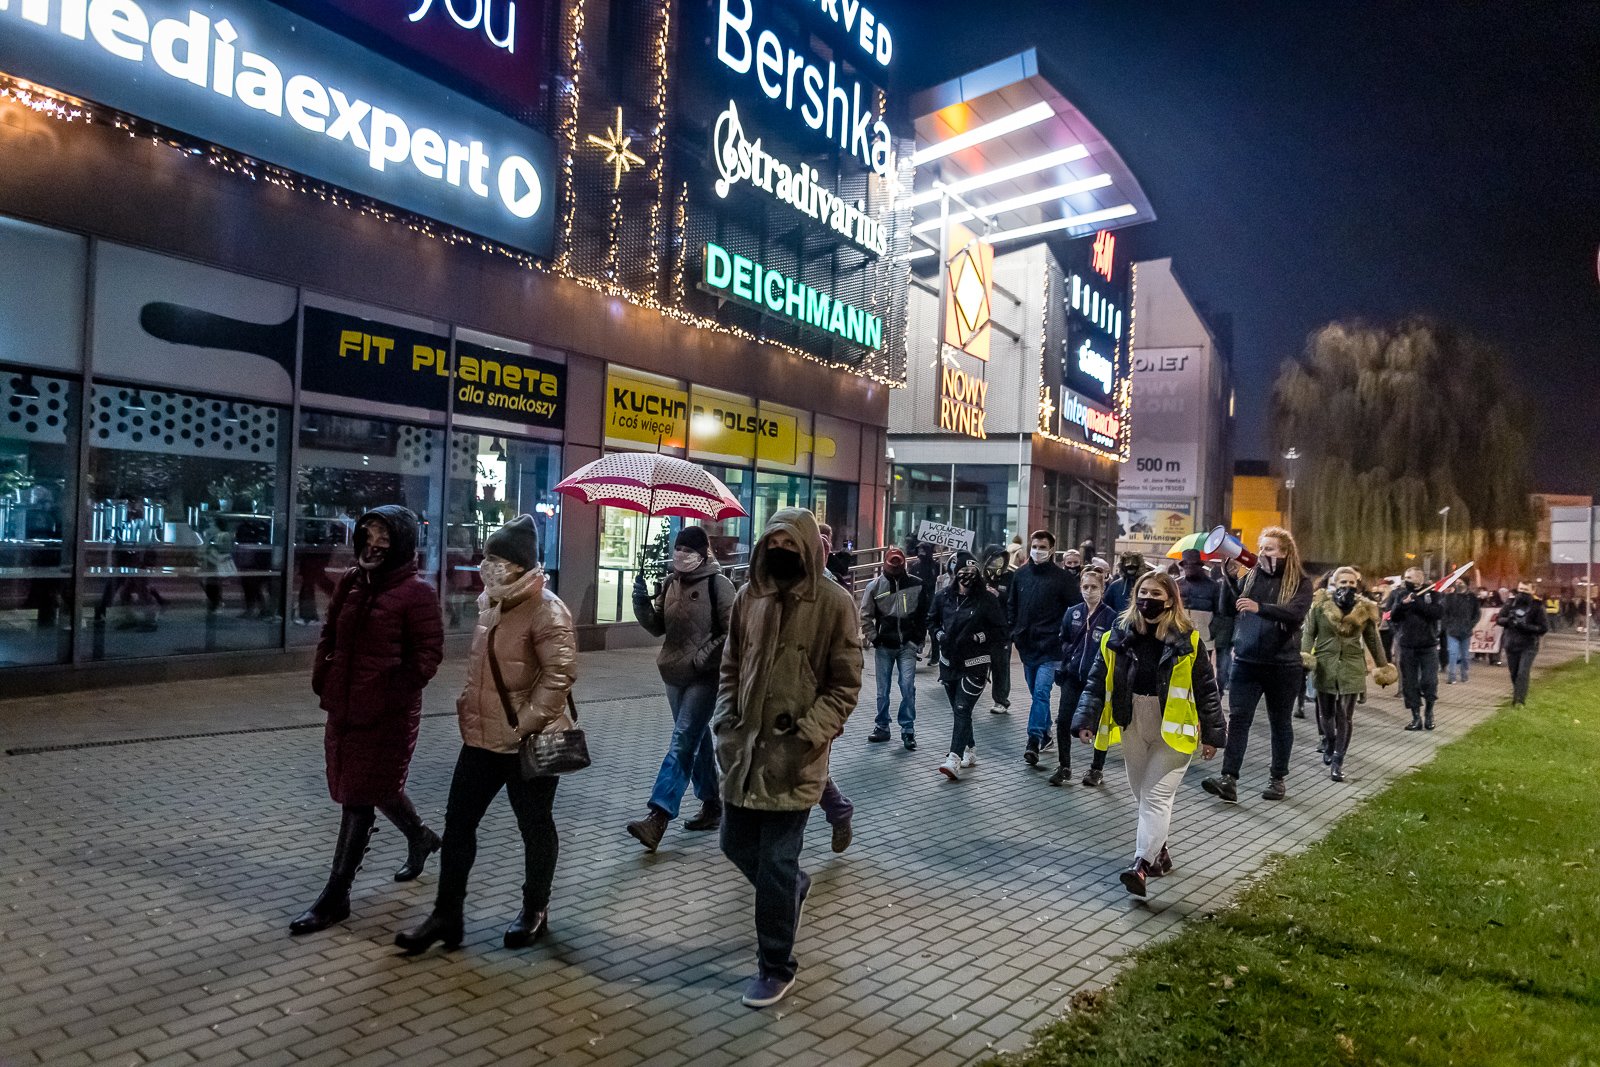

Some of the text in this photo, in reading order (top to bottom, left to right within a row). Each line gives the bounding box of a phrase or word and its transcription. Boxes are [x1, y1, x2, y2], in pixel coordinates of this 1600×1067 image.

[718, 0, 893, 178] Bershka
[706, 243, 882, 350] DEICHMANN
[339, 329, 394, 365] FIT
[458, 384, 557, 418] dla smakoszy
[942, 365, 989, 410] NOWY
[618, 415, 638, 430] coś
[641, 419, 675, 438] więcej
[940, 397, 987, 440] RYNEK
[1136, 457, 1180, 472] 500 m
[920, 531, 968, 550] KOBIETA
